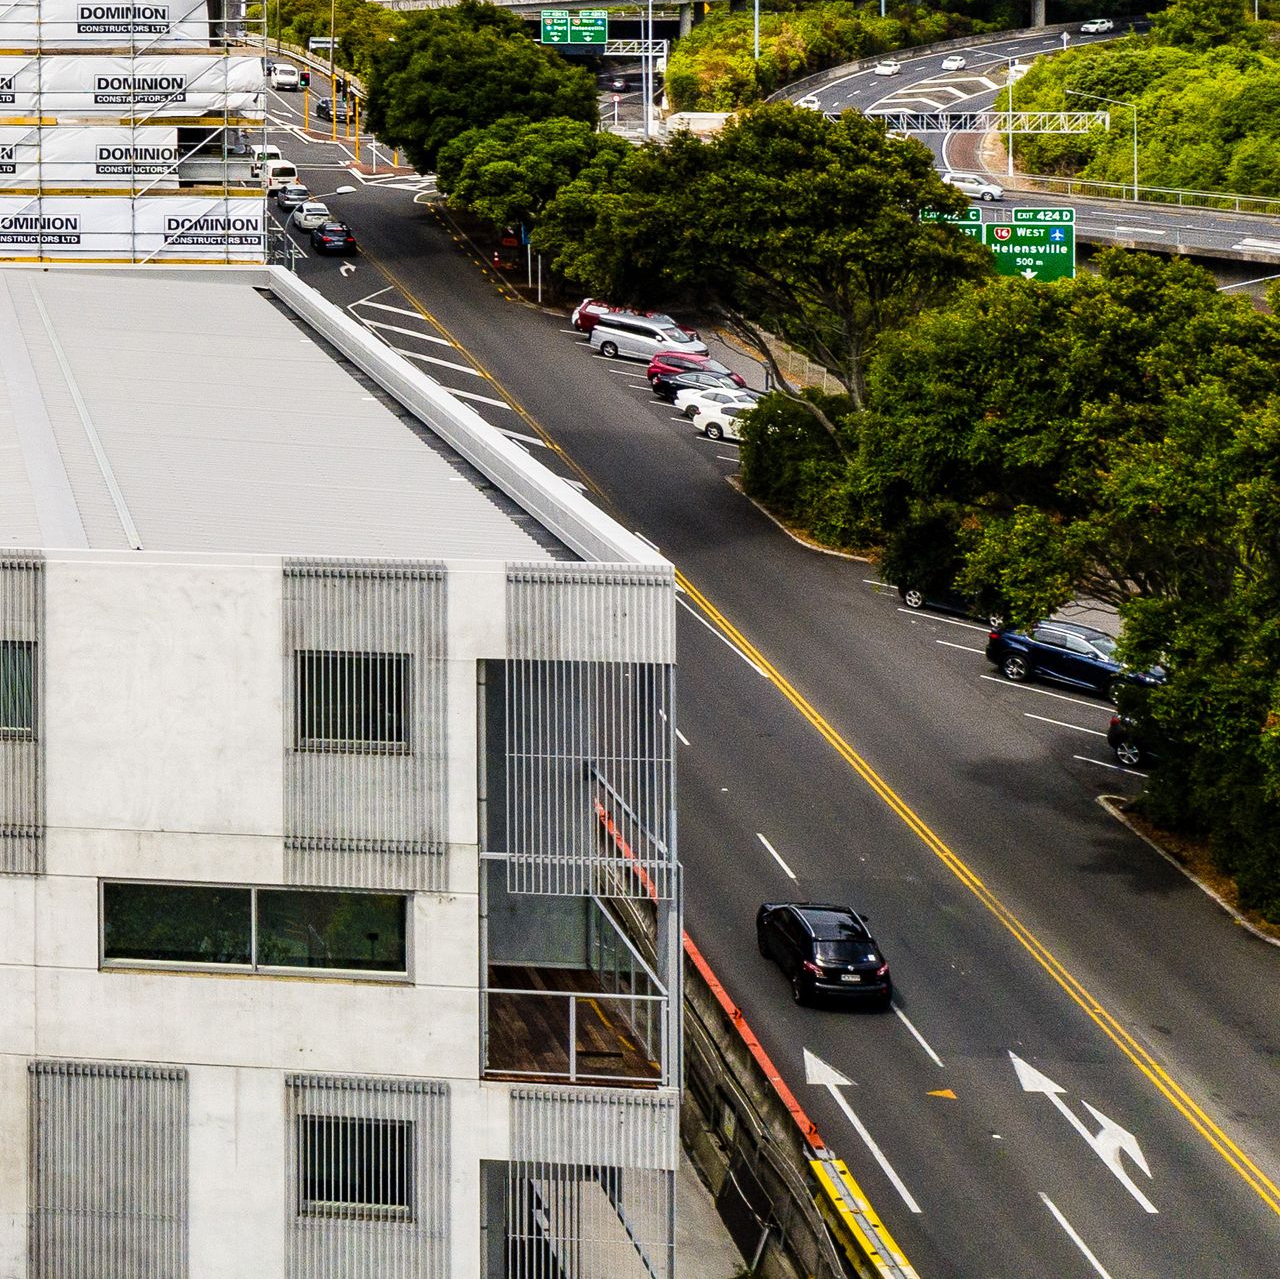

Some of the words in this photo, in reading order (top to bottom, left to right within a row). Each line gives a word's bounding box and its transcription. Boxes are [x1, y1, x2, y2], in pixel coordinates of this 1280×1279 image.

[1017, 212, 1033, 220] EXIT
[1036, 211, 1061, 220] 424
[1062, 211, 1071, 220] D
[997, 229, 1008, 237] 16
[1016, 227, 1045, 237] WEST
[991, 243, 1068, 254] Helensville
